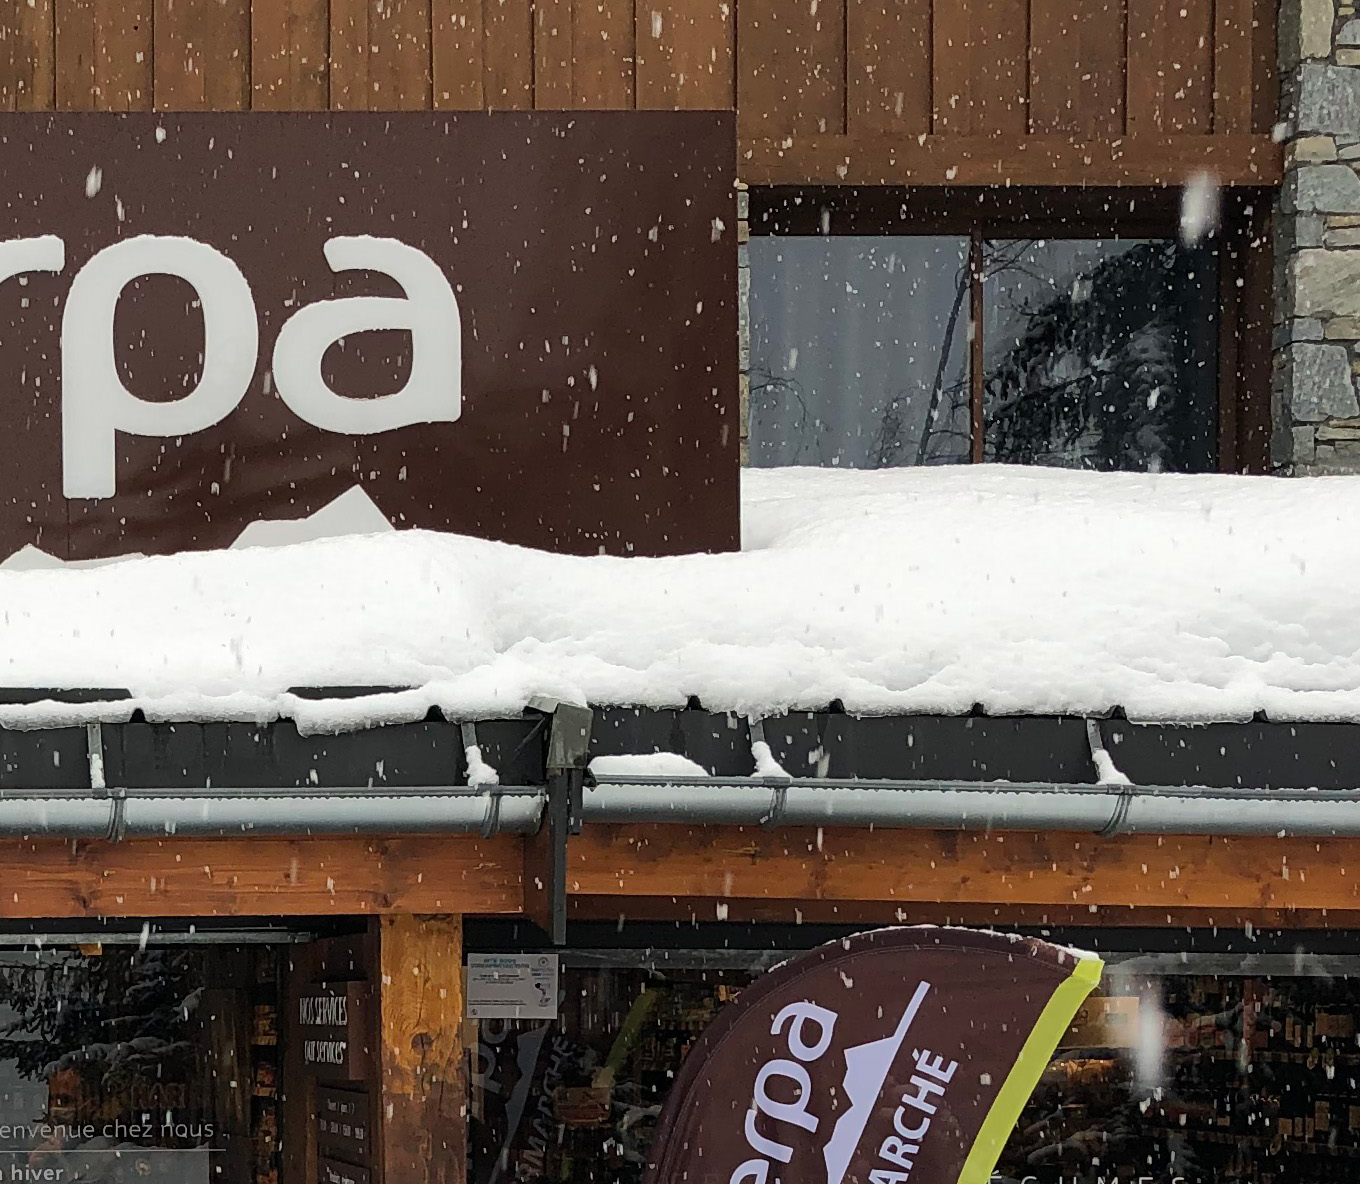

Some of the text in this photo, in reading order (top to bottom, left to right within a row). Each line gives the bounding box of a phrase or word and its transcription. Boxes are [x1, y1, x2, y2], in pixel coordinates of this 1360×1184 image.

[102, 1119, 153, 1138] chez
[160, 1121, 214, 1138] nous
[10, 1164, 64, 1181] hiver
